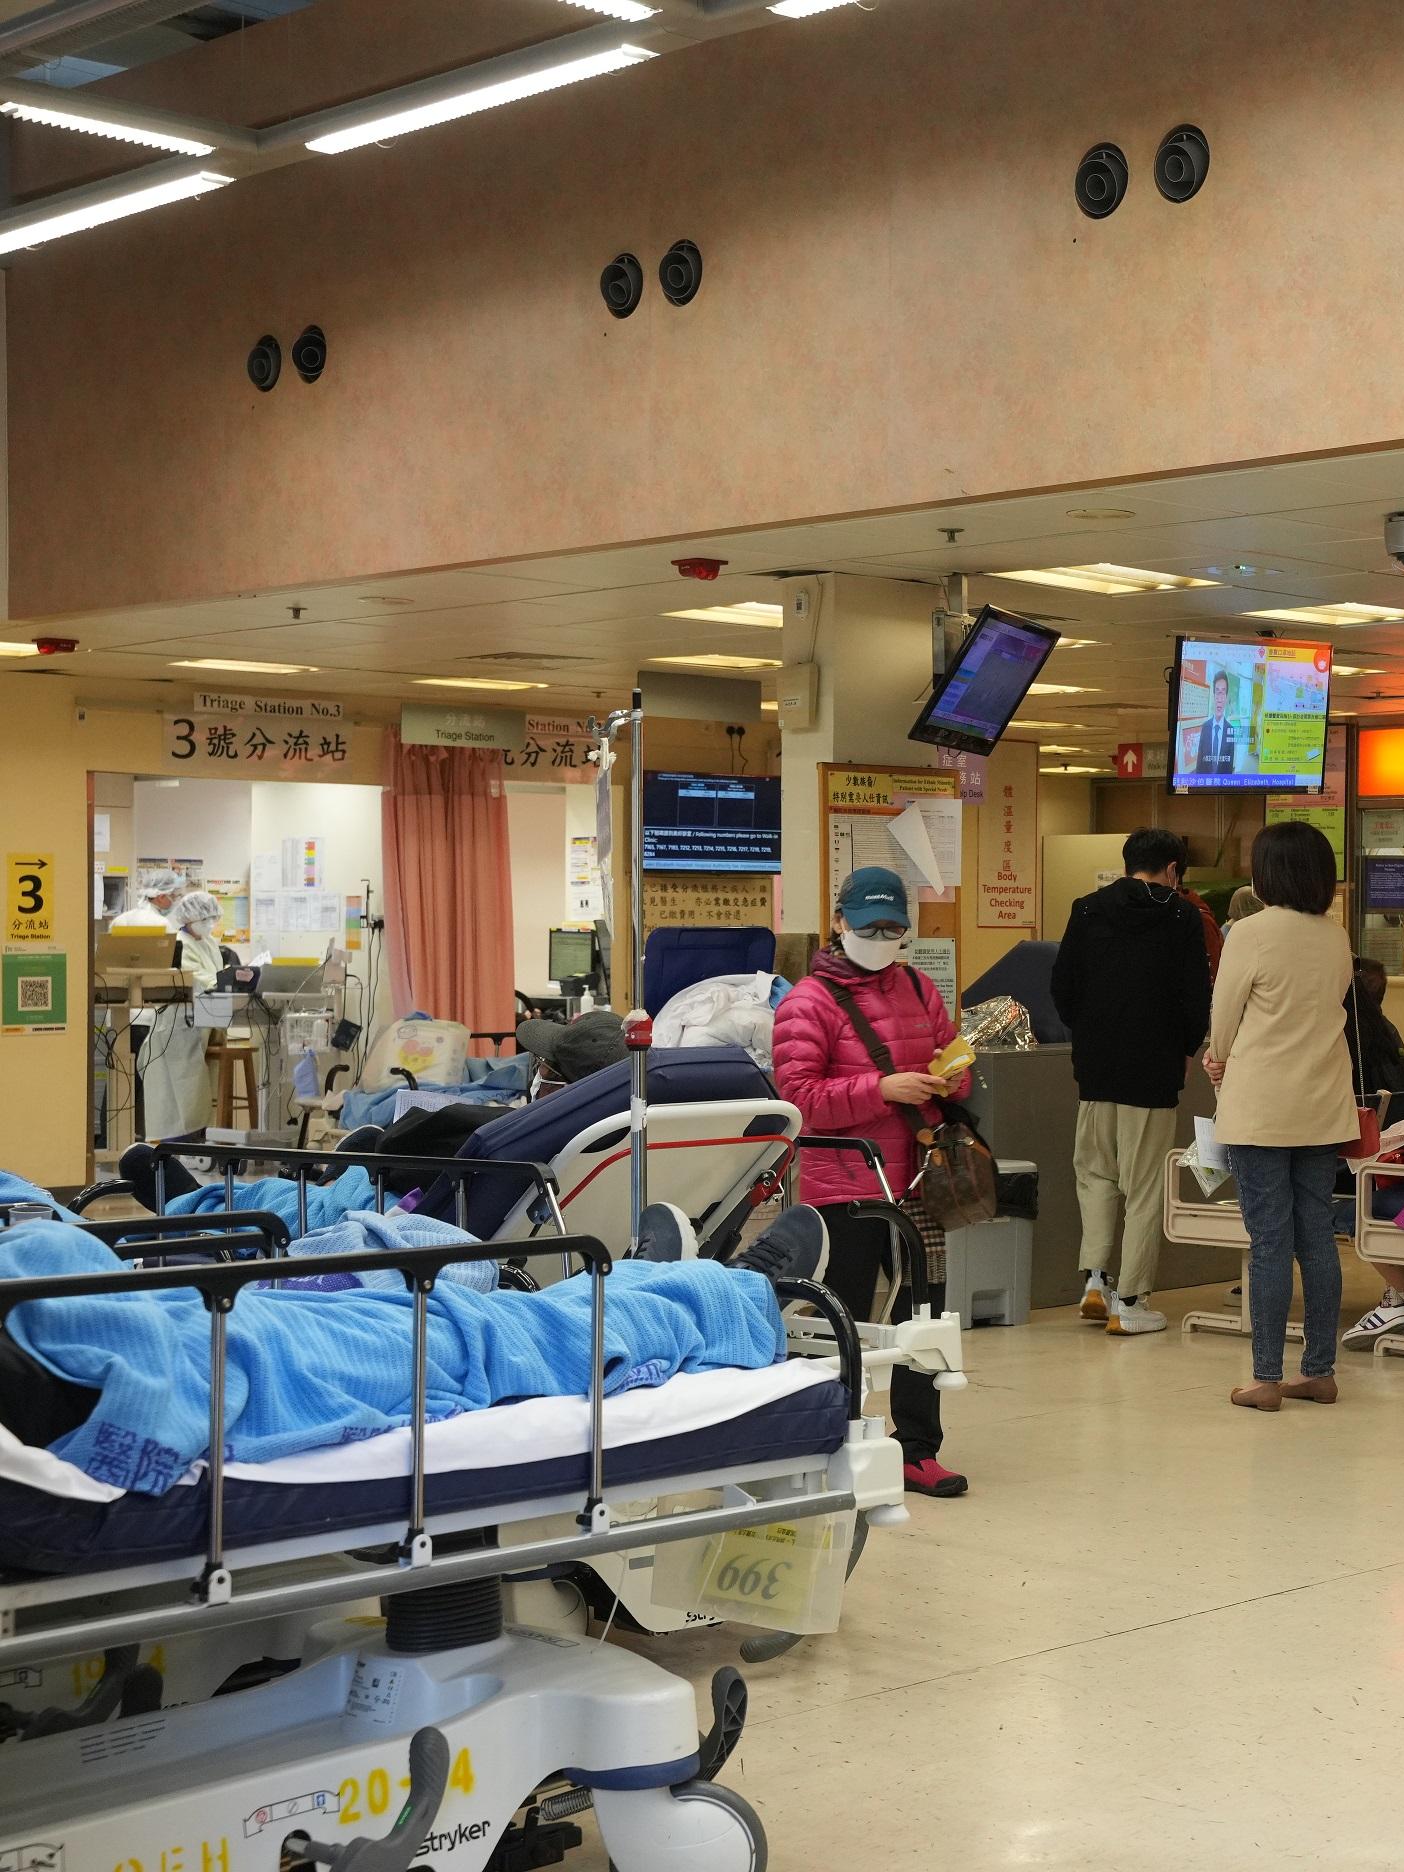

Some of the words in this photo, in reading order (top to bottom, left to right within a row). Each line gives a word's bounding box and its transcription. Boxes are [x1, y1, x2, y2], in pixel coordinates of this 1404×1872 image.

[200, 694, 246, 713] Triage
[254, 700, 303, 715] Station
[310, 703, 341, 717] No.3
[528, 719, 569, 733] Station
[171, 718, 347, 762] 3號分流站
[435, 729, 463, 741] Triage
[465, 731, 494, 742] Station
[1223, 778, 1241, 786] Queen
[1272, 778, 1294, 786] Hospital
[968, 789, 984, 798] Desk
[997, 872, 1017, 883] Body
[17, 874, 44, 914] 3
[982, 884, 1032, 895] Temperature
[989, 898, 1025, 910] Checking
[997, 911, 1016, 920] Area
[12, 919, 49, 930] 分流站
[338, 1747, 475, 1825] 20-4
[414, 1820, 491, 1857] stryker
